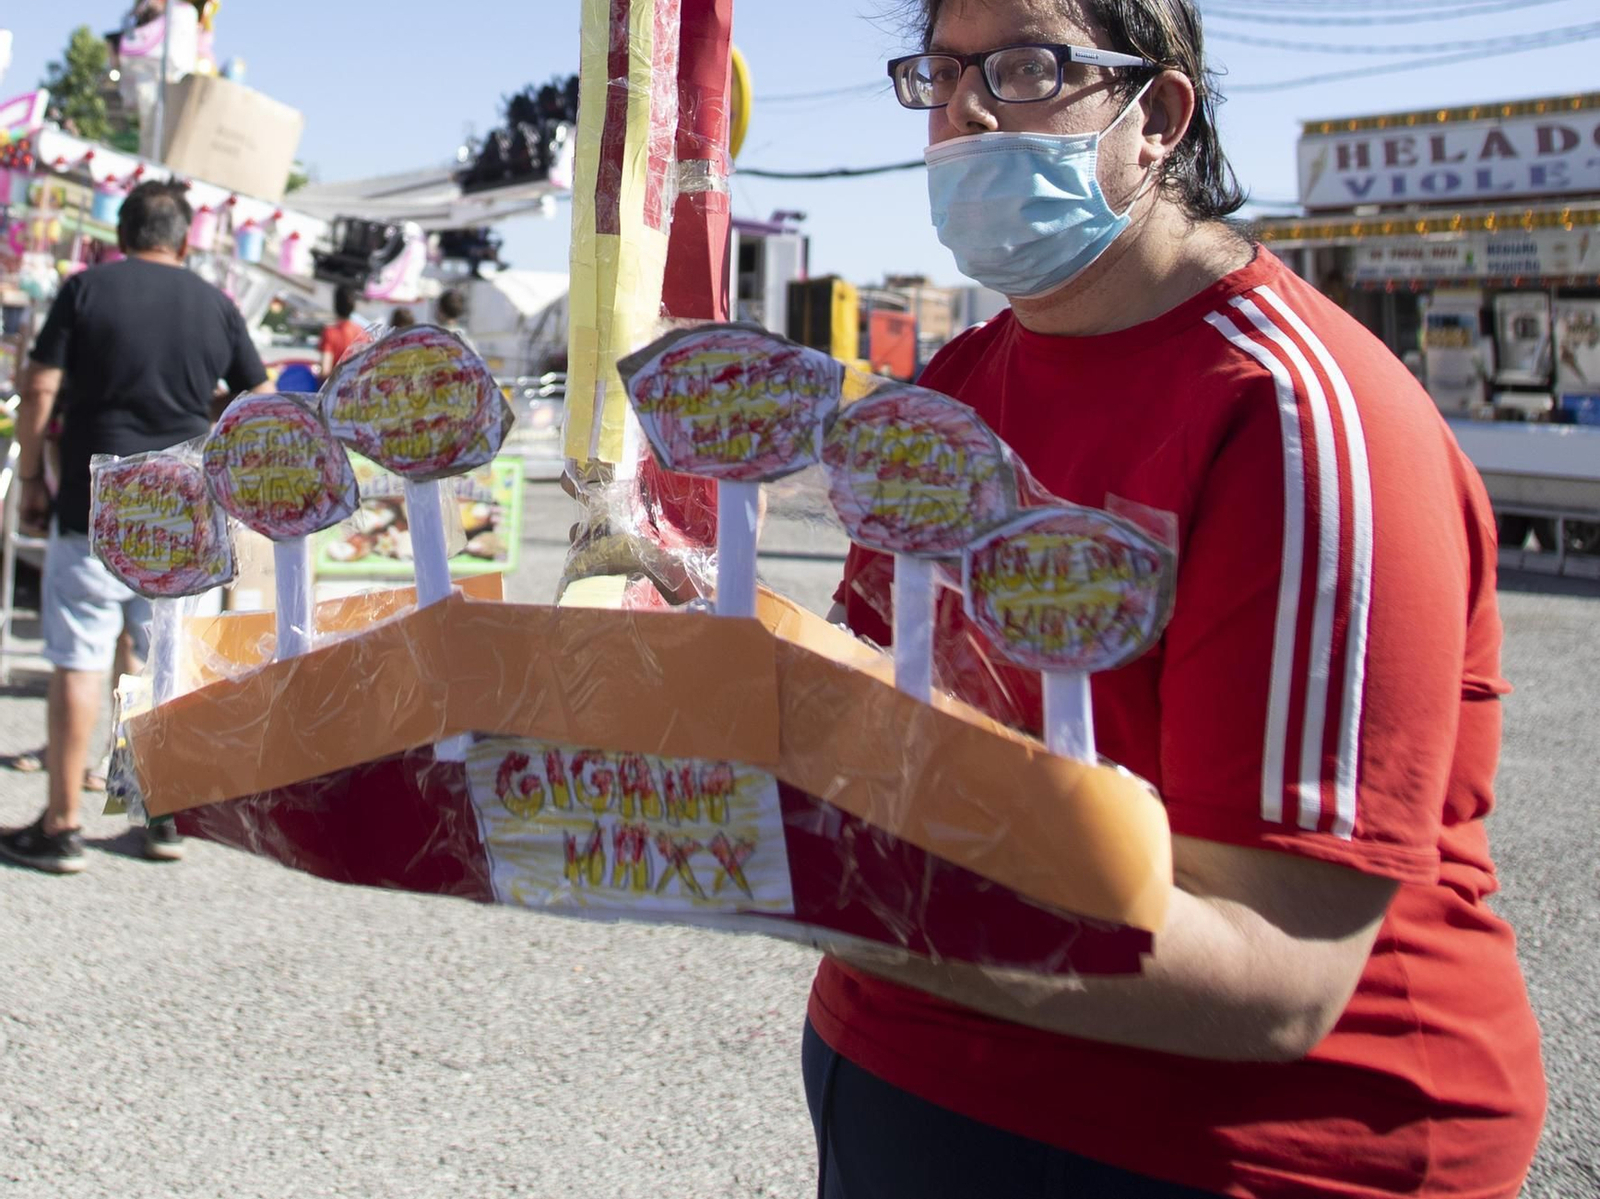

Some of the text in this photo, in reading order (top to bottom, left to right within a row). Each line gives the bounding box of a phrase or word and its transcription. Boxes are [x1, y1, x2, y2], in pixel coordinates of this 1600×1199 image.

[1336, 123, 1600, 171] HELAD
[1344, 157, 1600, 200] VIOLE
[495, 748, 735, 827] GIGANT
[563, 819, 757, 900] MAXX
